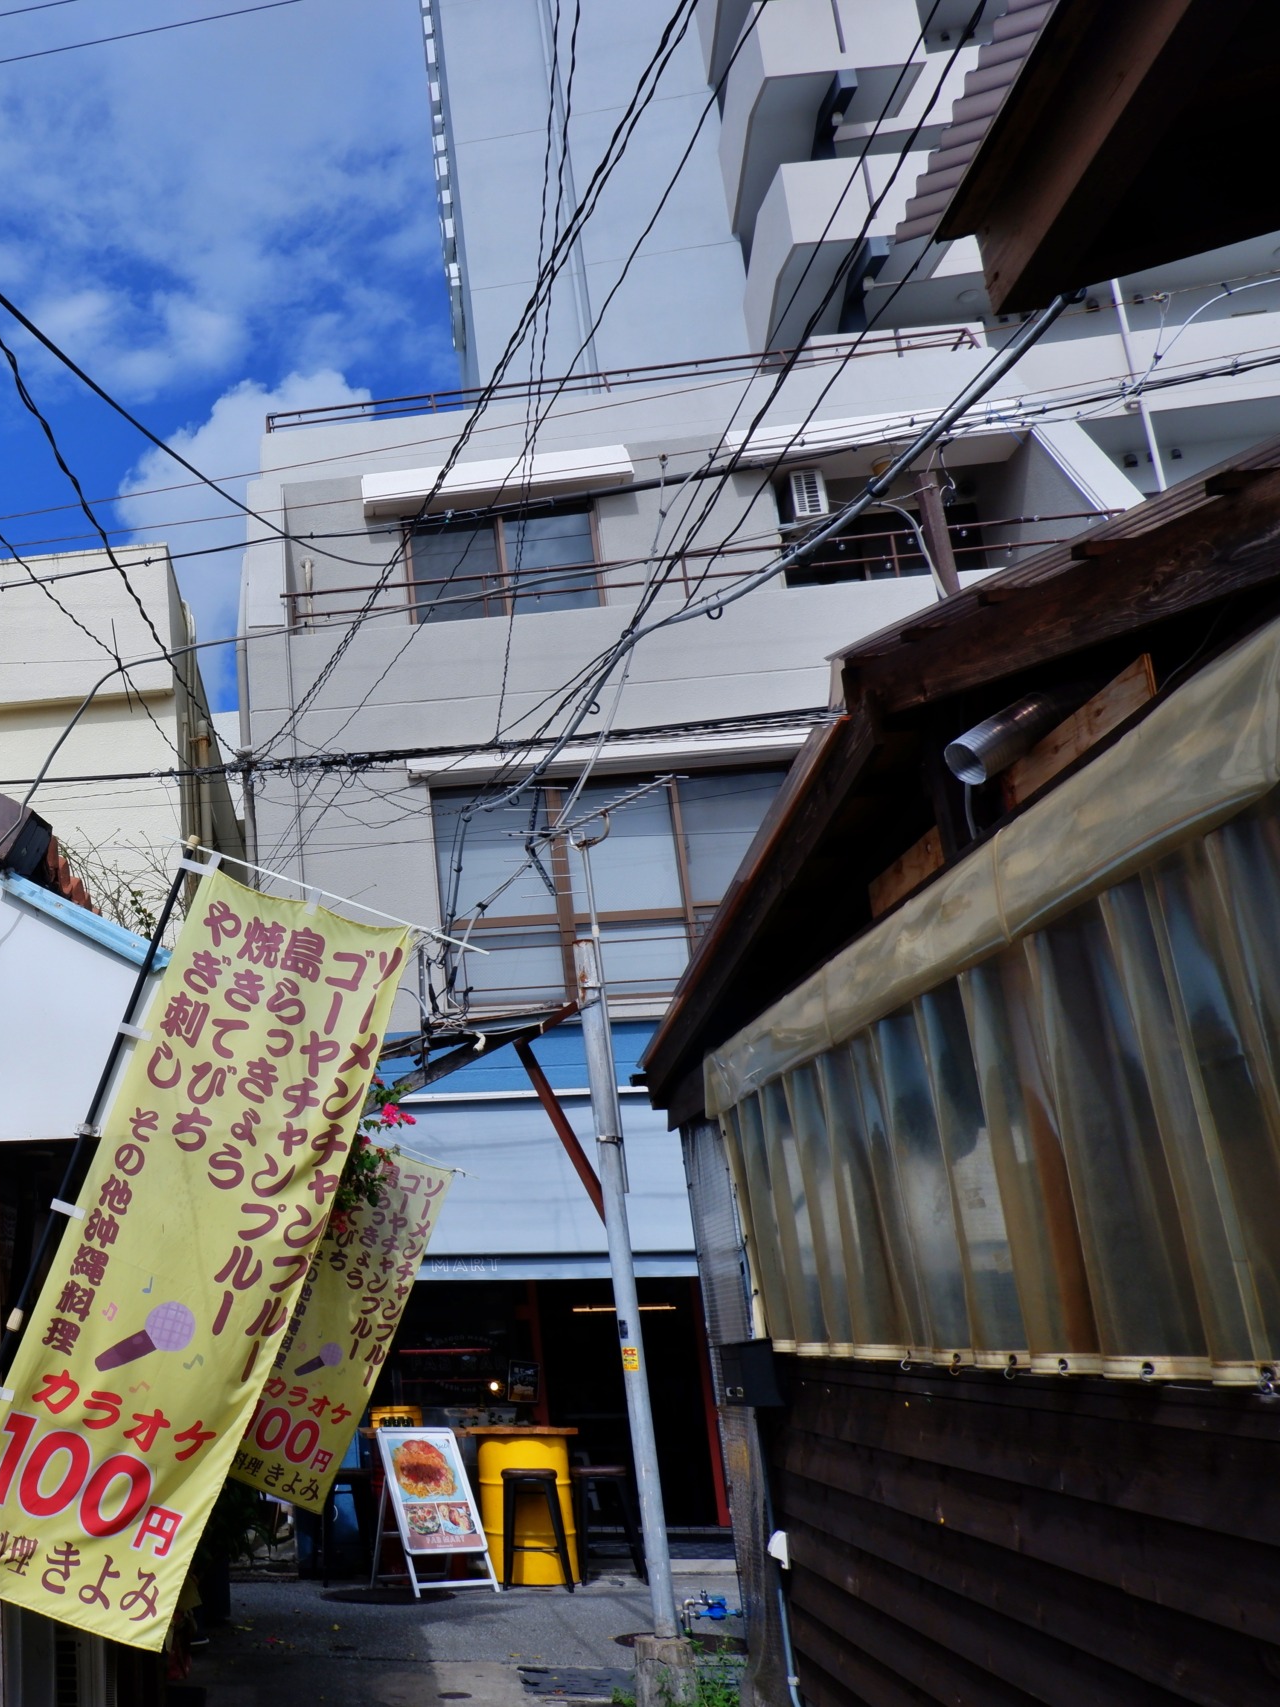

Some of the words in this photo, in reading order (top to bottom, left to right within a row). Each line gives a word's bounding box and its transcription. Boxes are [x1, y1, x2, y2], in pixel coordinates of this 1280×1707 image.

[146, 900, 241, 1089] やぎ刺し
[172, 916, 286, 1152] 焼きてびち
[207, 926, 325, 1190] 島らっきょう
[41, 1106, 159, 1357] その他沖縄料理
[431, 1257, 501, 1273] MART
[31, 1369, 216, 1461] カラオケ
[263, 1376, 352, 1425] カラオケ
[264, 1463, 320, 1501] きよみ
[40, 1540, 161, 1622] きよみ
